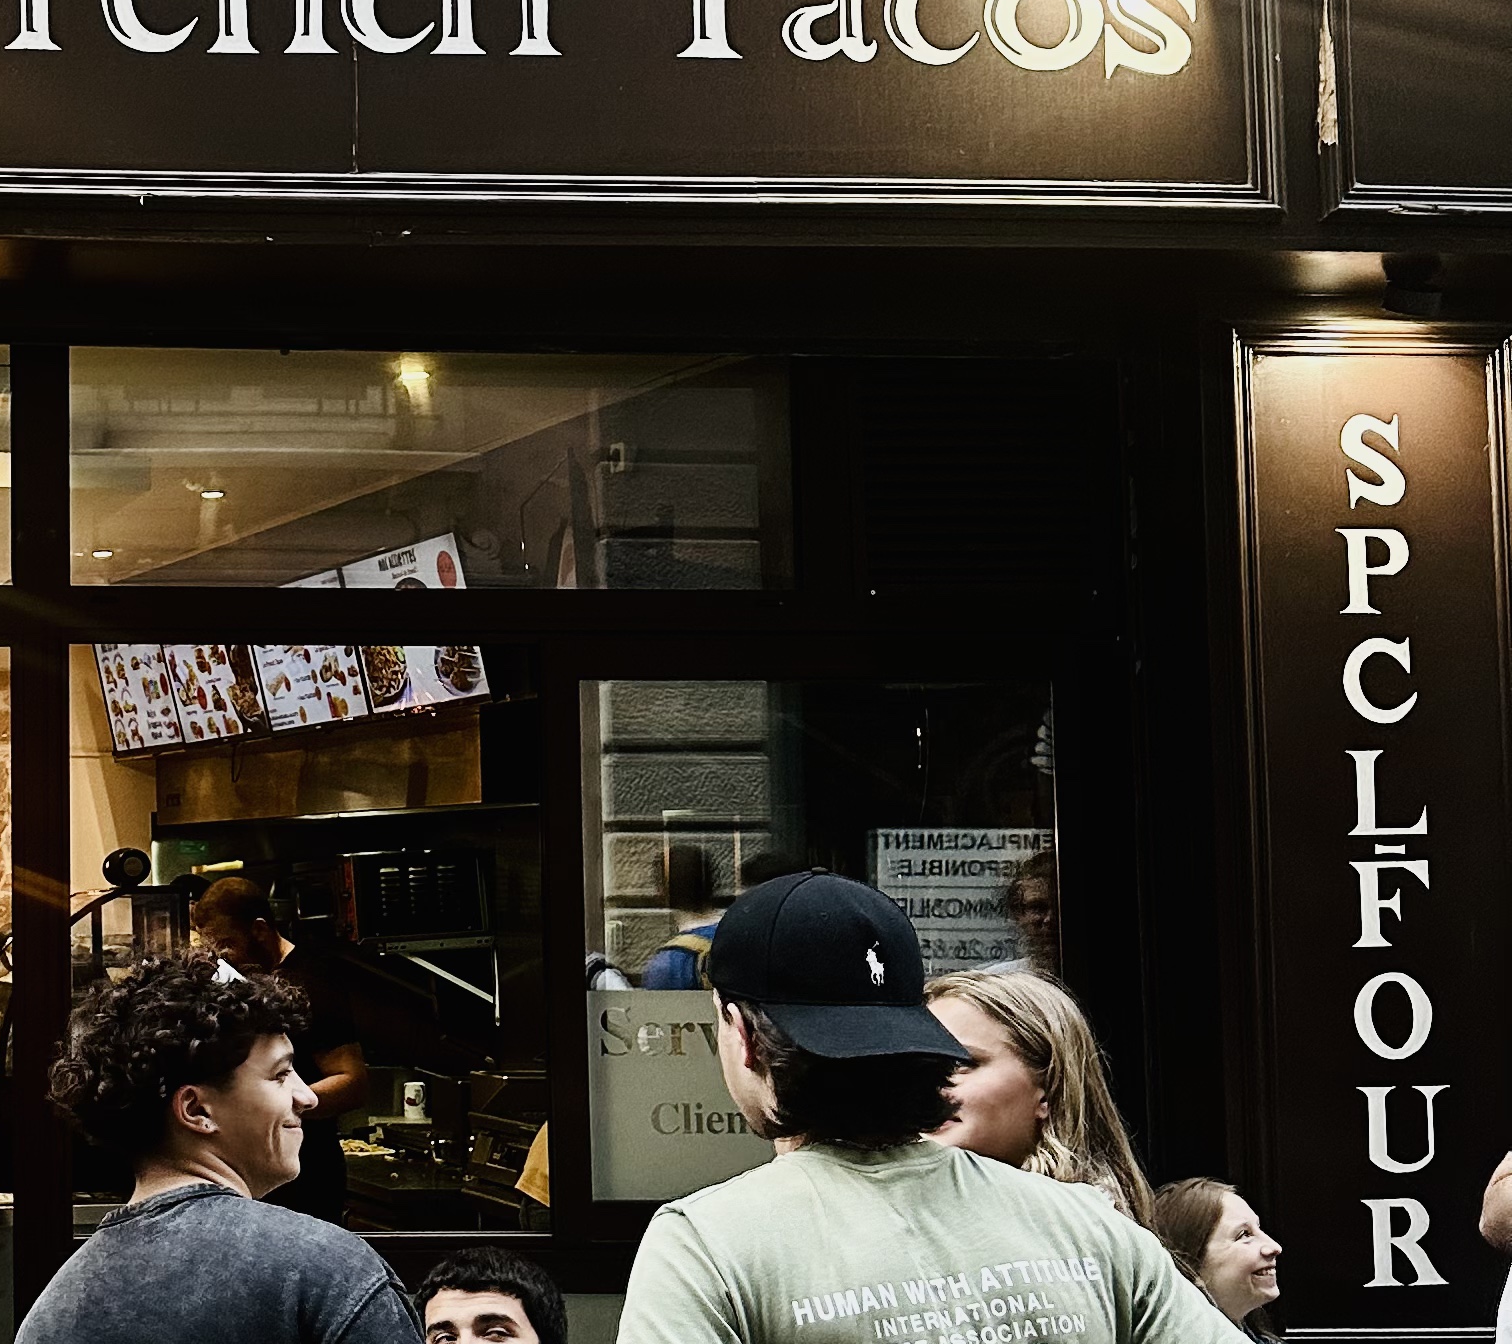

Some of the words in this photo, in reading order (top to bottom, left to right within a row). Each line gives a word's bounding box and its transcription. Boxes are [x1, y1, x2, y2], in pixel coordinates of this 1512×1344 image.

[651, 1102, 752, 1134] Clien
[791, 1283, 898, 1326] HUMAN
[902, 1272, 971, 1304] WITH
[980, 1257, 1103, 1292] ATTITUDE
[874, 1291, 1055, 1339] INTERNATIONAL
